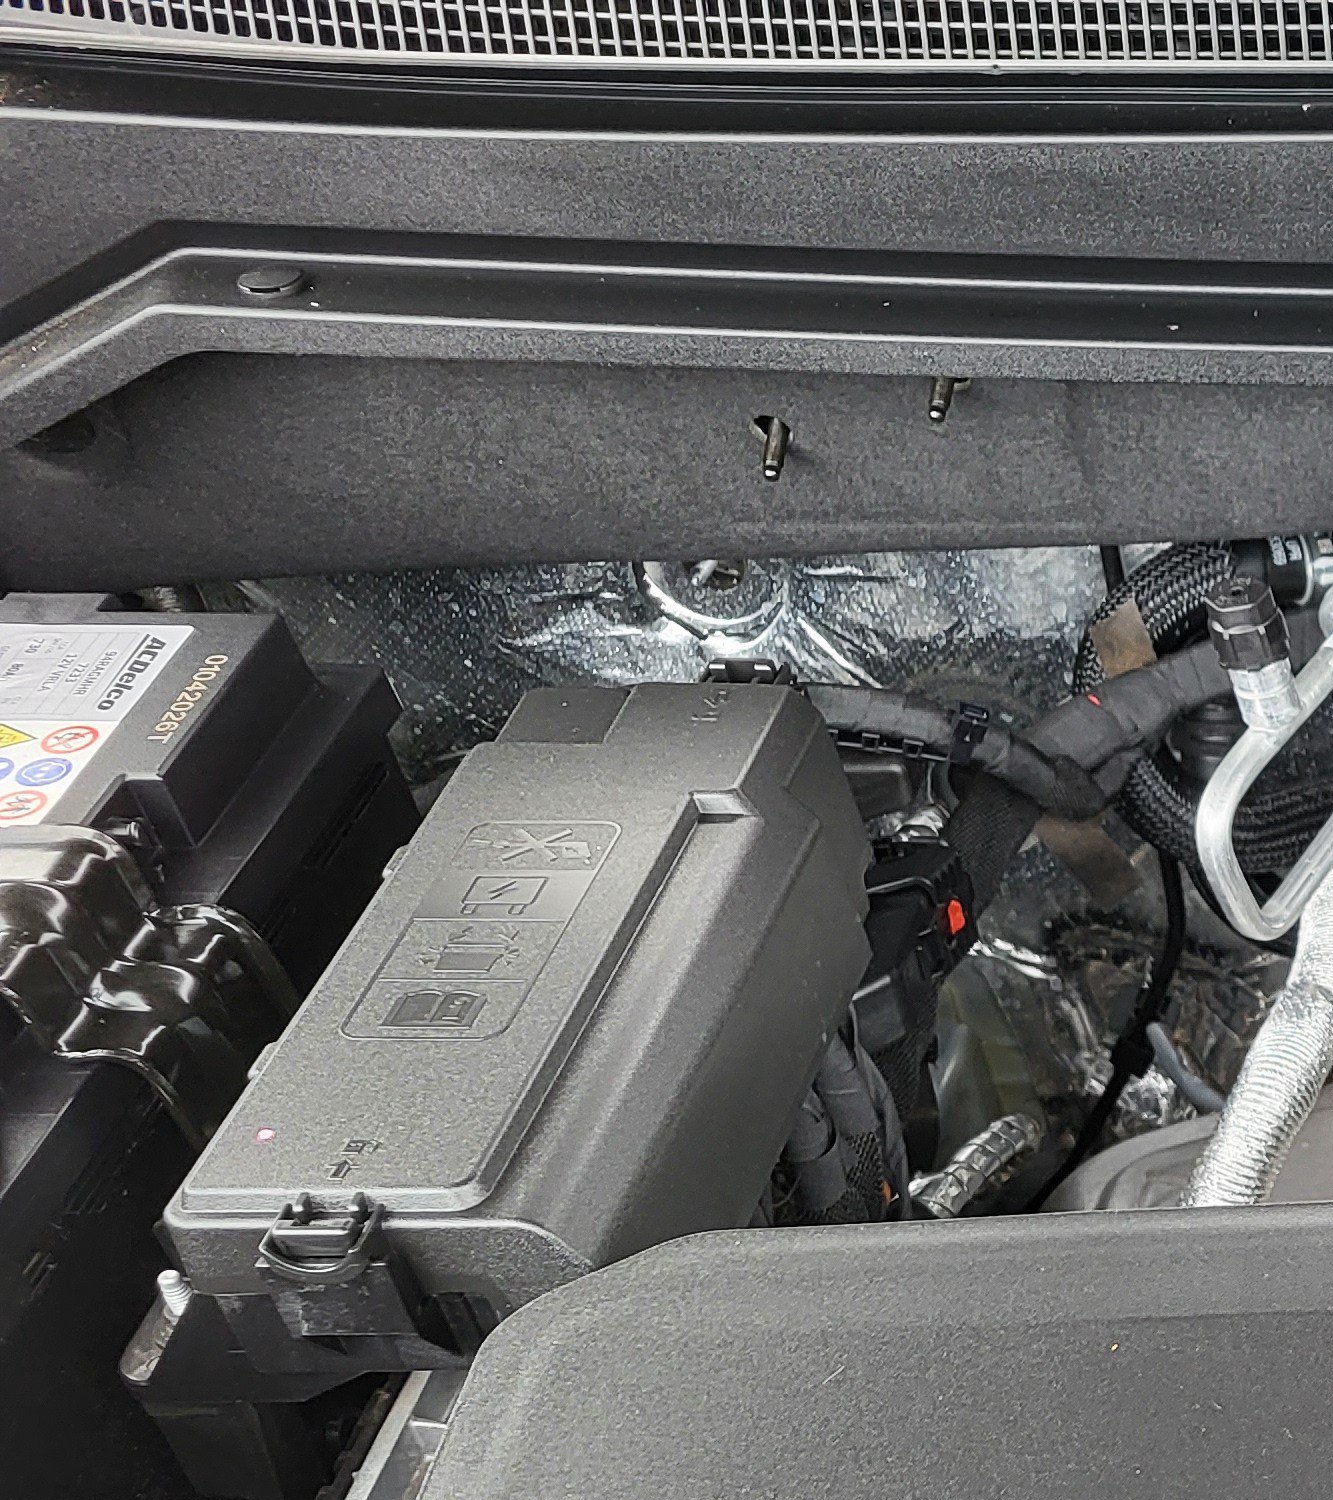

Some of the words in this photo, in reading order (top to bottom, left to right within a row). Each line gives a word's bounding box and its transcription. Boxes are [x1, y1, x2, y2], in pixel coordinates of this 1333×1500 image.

[36, 670, 65, 692] VRLA
[97, 635, 168, 711] ACDelco
[147, 654, 229, 745] 01042026T
